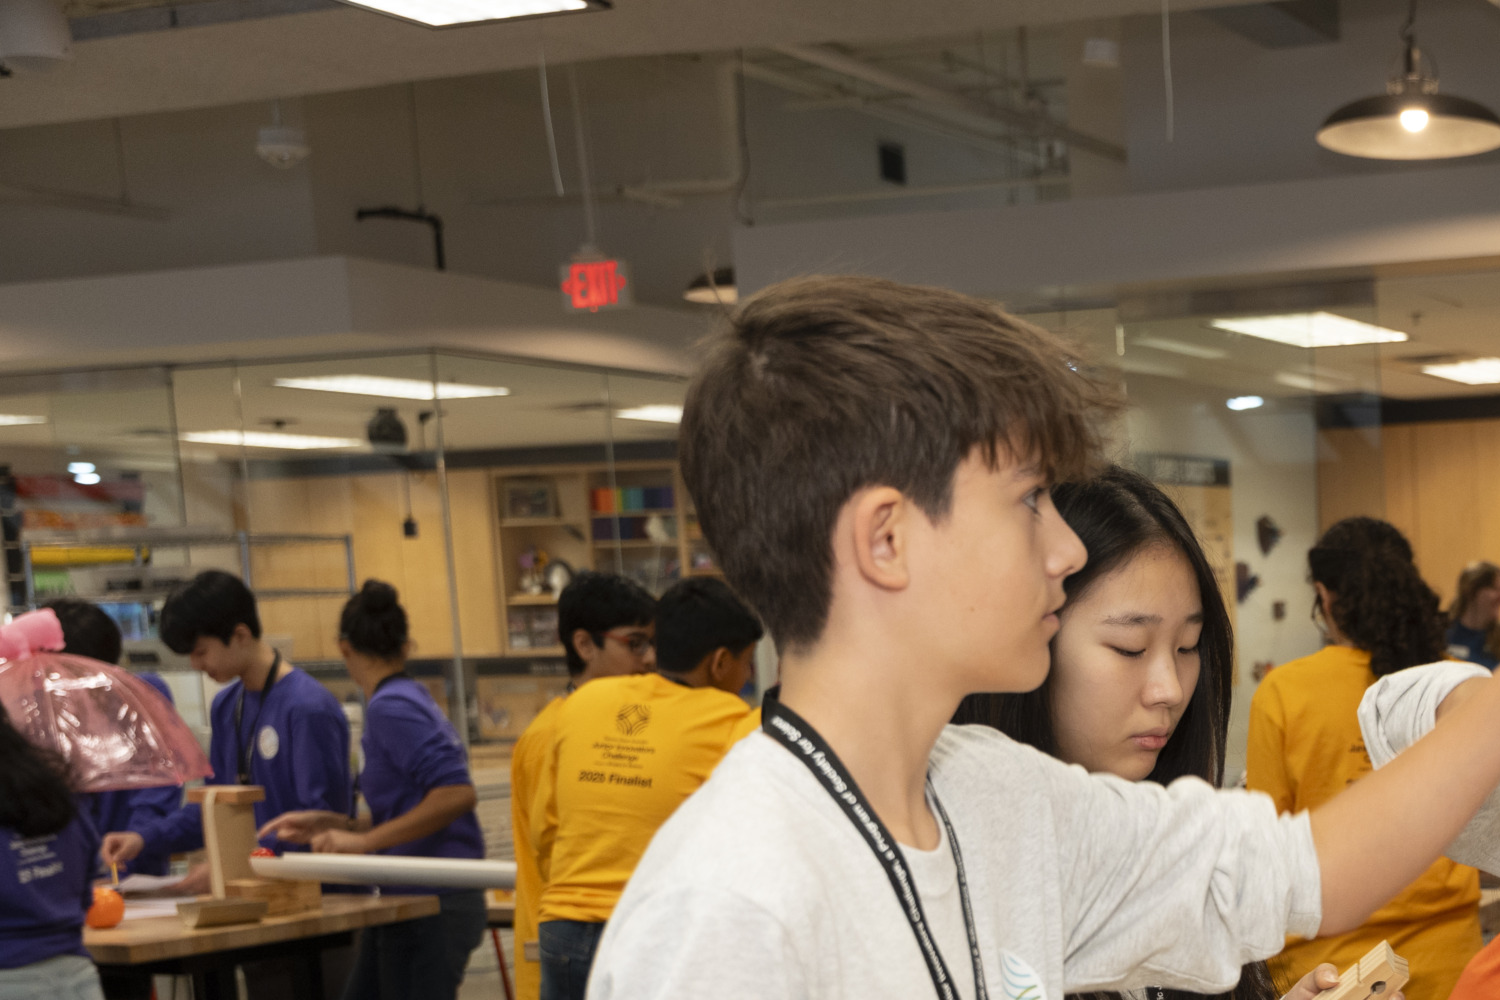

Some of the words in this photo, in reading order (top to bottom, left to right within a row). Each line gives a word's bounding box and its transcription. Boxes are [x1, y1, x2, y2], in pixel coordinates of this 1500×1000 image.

[570, 260, 618, 308] EXIT
[798, 737, 817, 756] for
[578, 771, 606, 784] 2025
[608, 773, 653, 789] Finalist
[812, 750, 848, 793] Society
[842, 791, 858, 805] of
[852, 803, 890, 853] Program
[885, 849, 896, 860] a
[917, 920, 947, 983] Innovators
